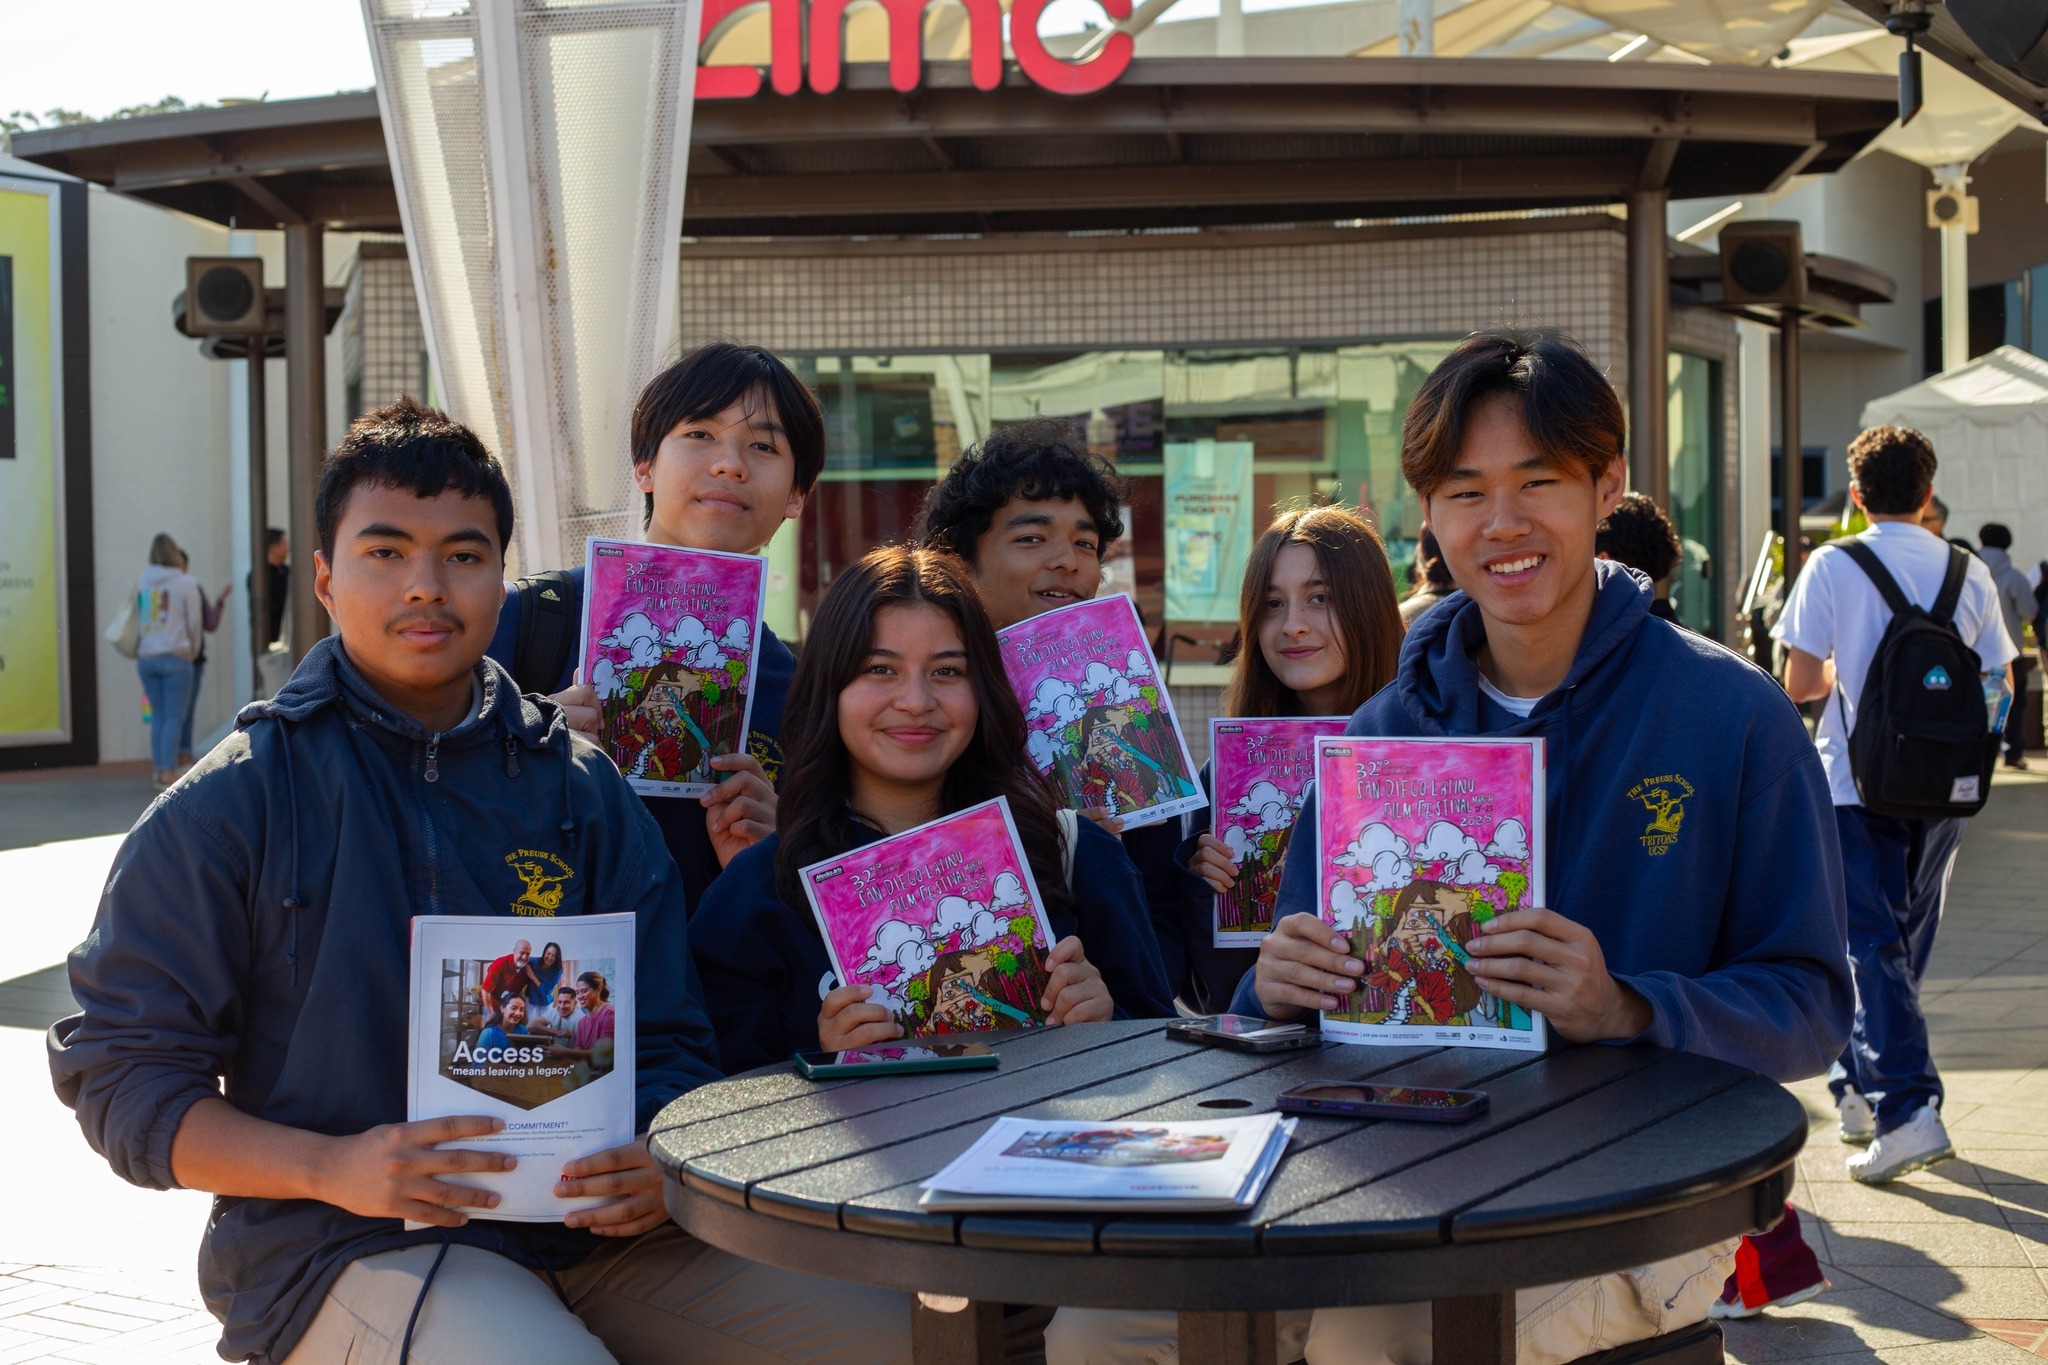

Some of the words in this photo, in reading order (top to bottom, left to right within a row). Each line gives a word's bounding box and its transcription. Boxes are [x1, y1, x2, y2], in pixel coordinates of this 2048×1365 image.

[625, 578, 646, 594] SAN
[648, 579, 680, 595] DIEGO
[682, 582, 717, 596] LATINO
[645, 597, 667, 612] FILM
[670, 597, 712, 613] FESTIVAL
[1021, 648, 1042, 669] SAN
[1042, 637, 1074, 659] DIEGO
[1075, 627, 1105, 647] LATINO
[1046, 657, 1070, 674] FILM
[1070, 642, 1107, 665] FESTIVAL
[1247, 749, 1267, 765] SAN
[1270, 748, 1302, 762] DIEGO
[1269, 765, 1291, 779] FILM
[1356, 779, 1381, 799] SAN
[1384, 779, 1427, 798] DIEGO
[1430, 777, 1475, 797] LATINO
[1383, 802, 1412, 819] FILM
[1417, 798, 1472, 819] FESTIVAL
[1459, 813, 1493, 827] 2025
[1639, 833, 1678, 847] TRITONS
[518, 848, 549, 859] PREUSS
[549, 853, 575, 878] SCHOOL
[858, 885, 884, 908] SAN
[884, 869, 923, 896] DIEGO
[924, 849, 964, 879] LATINO
[960, 875, 988, 896] 2025
[889, 894, 918, 915] FILM
[918, 870, 969, 901] FESTIVAL
[510, 902, 556, 917] TRITONS
[452, 1040, 544, 1064] Access
[488, 1066, 526, 1078] leaving
[527, 1068, 534, 1076] a
